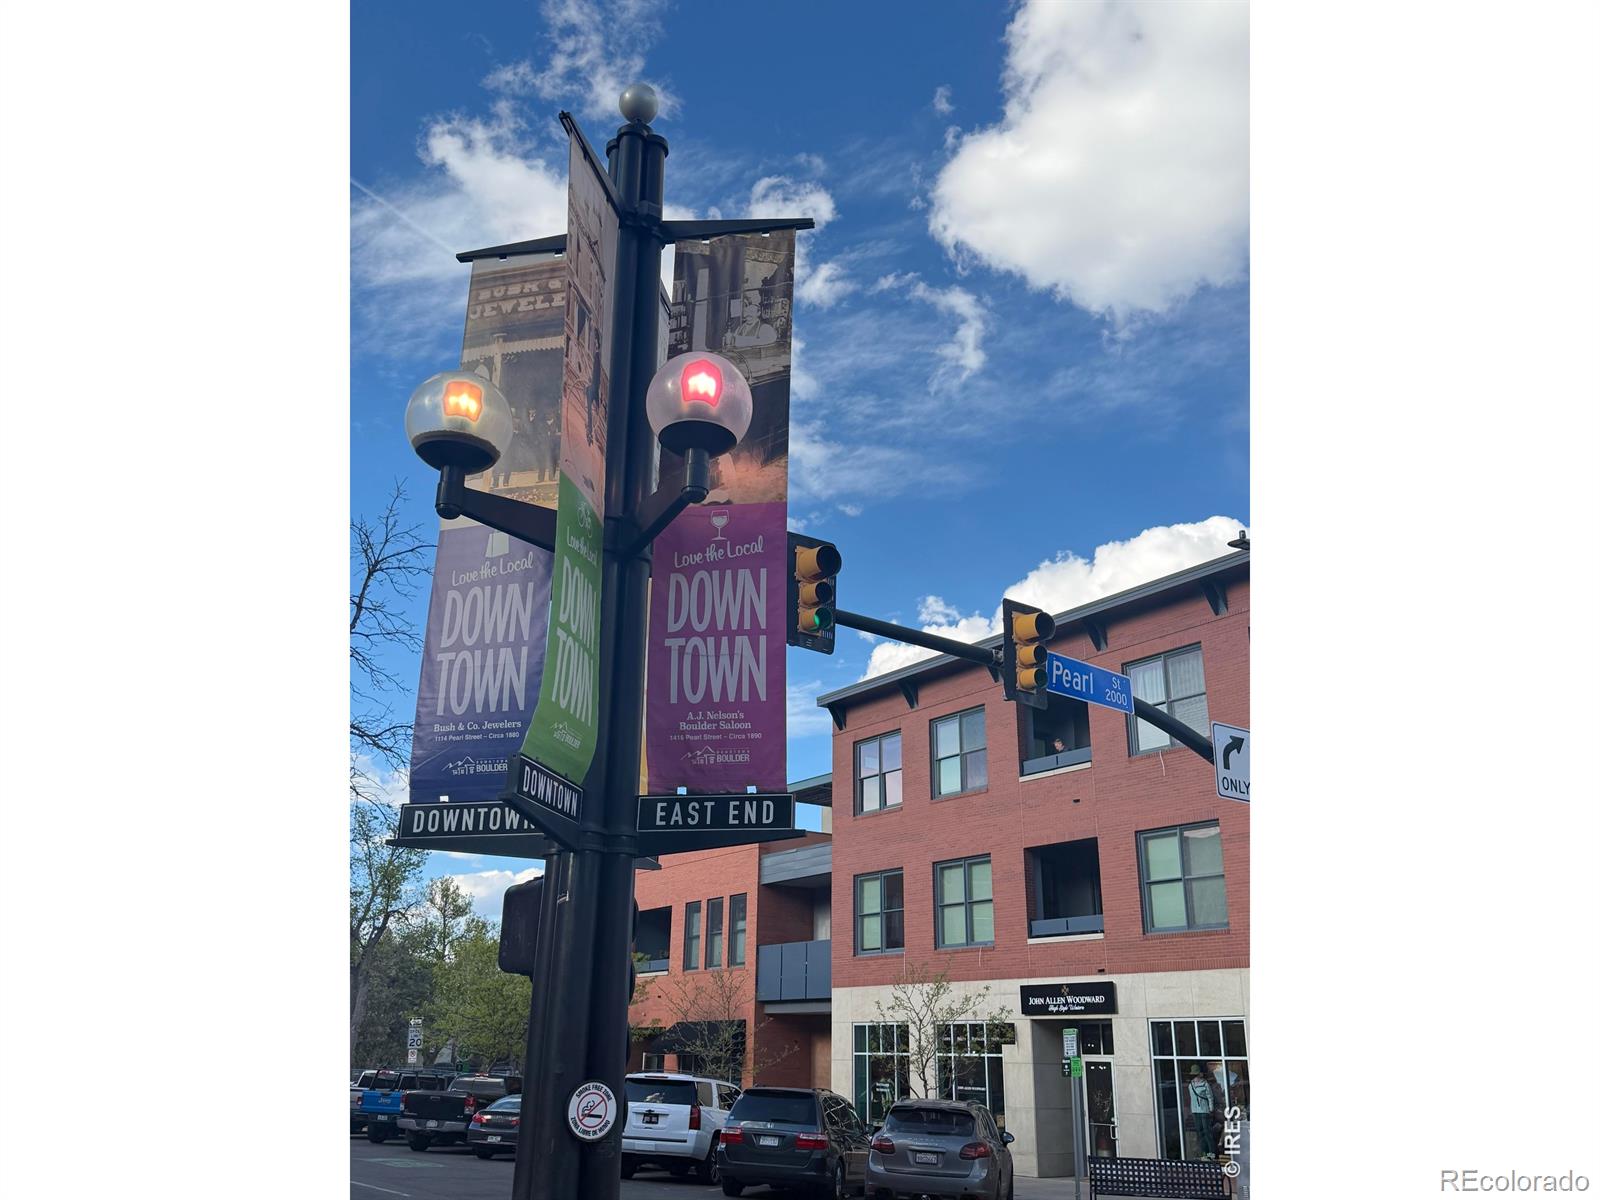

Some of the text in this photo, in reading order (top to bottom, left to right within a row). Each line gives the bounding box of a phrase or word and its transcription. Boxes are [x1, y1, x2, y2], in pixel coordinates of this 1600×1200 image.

[674, 535, 764, 568] Love the Local
[452, 551, 534, 586] Love the Local
[559, 555, 597, 653] DOWN
[667, 568, 768, 633] DOWN
[440, 582, 534, 648] DOWN
[436, 646, 527, 717] TOWN
[552, 626, 593, 726] TOWN
[664, 635, 767, 704] TOWN
[1052, 659, 1094, 694] Pearl
[1112, 676, 1121, 690] St
[1105, 689, 1128, 706] 2000
[433, 719, 522, 732] Bush & Co. Jewelers
[679, 720, 752, 730] Boulder Saloon
[687, 710, 744, 720] A.J. Nelson's
[476, 763, 508, 772] BOULDER
[716, 753, 750, 762] BOULDER
[522, 765, 578, 817] DOWNTOWN
[1222, 776, 1250, 795] ONLY
[655, 799, 775, 826] EAST END
[1028, 995, 1105, 1005] JOHN ALLEN WOODWARD
[409, 1038, 422, 1047] 20
